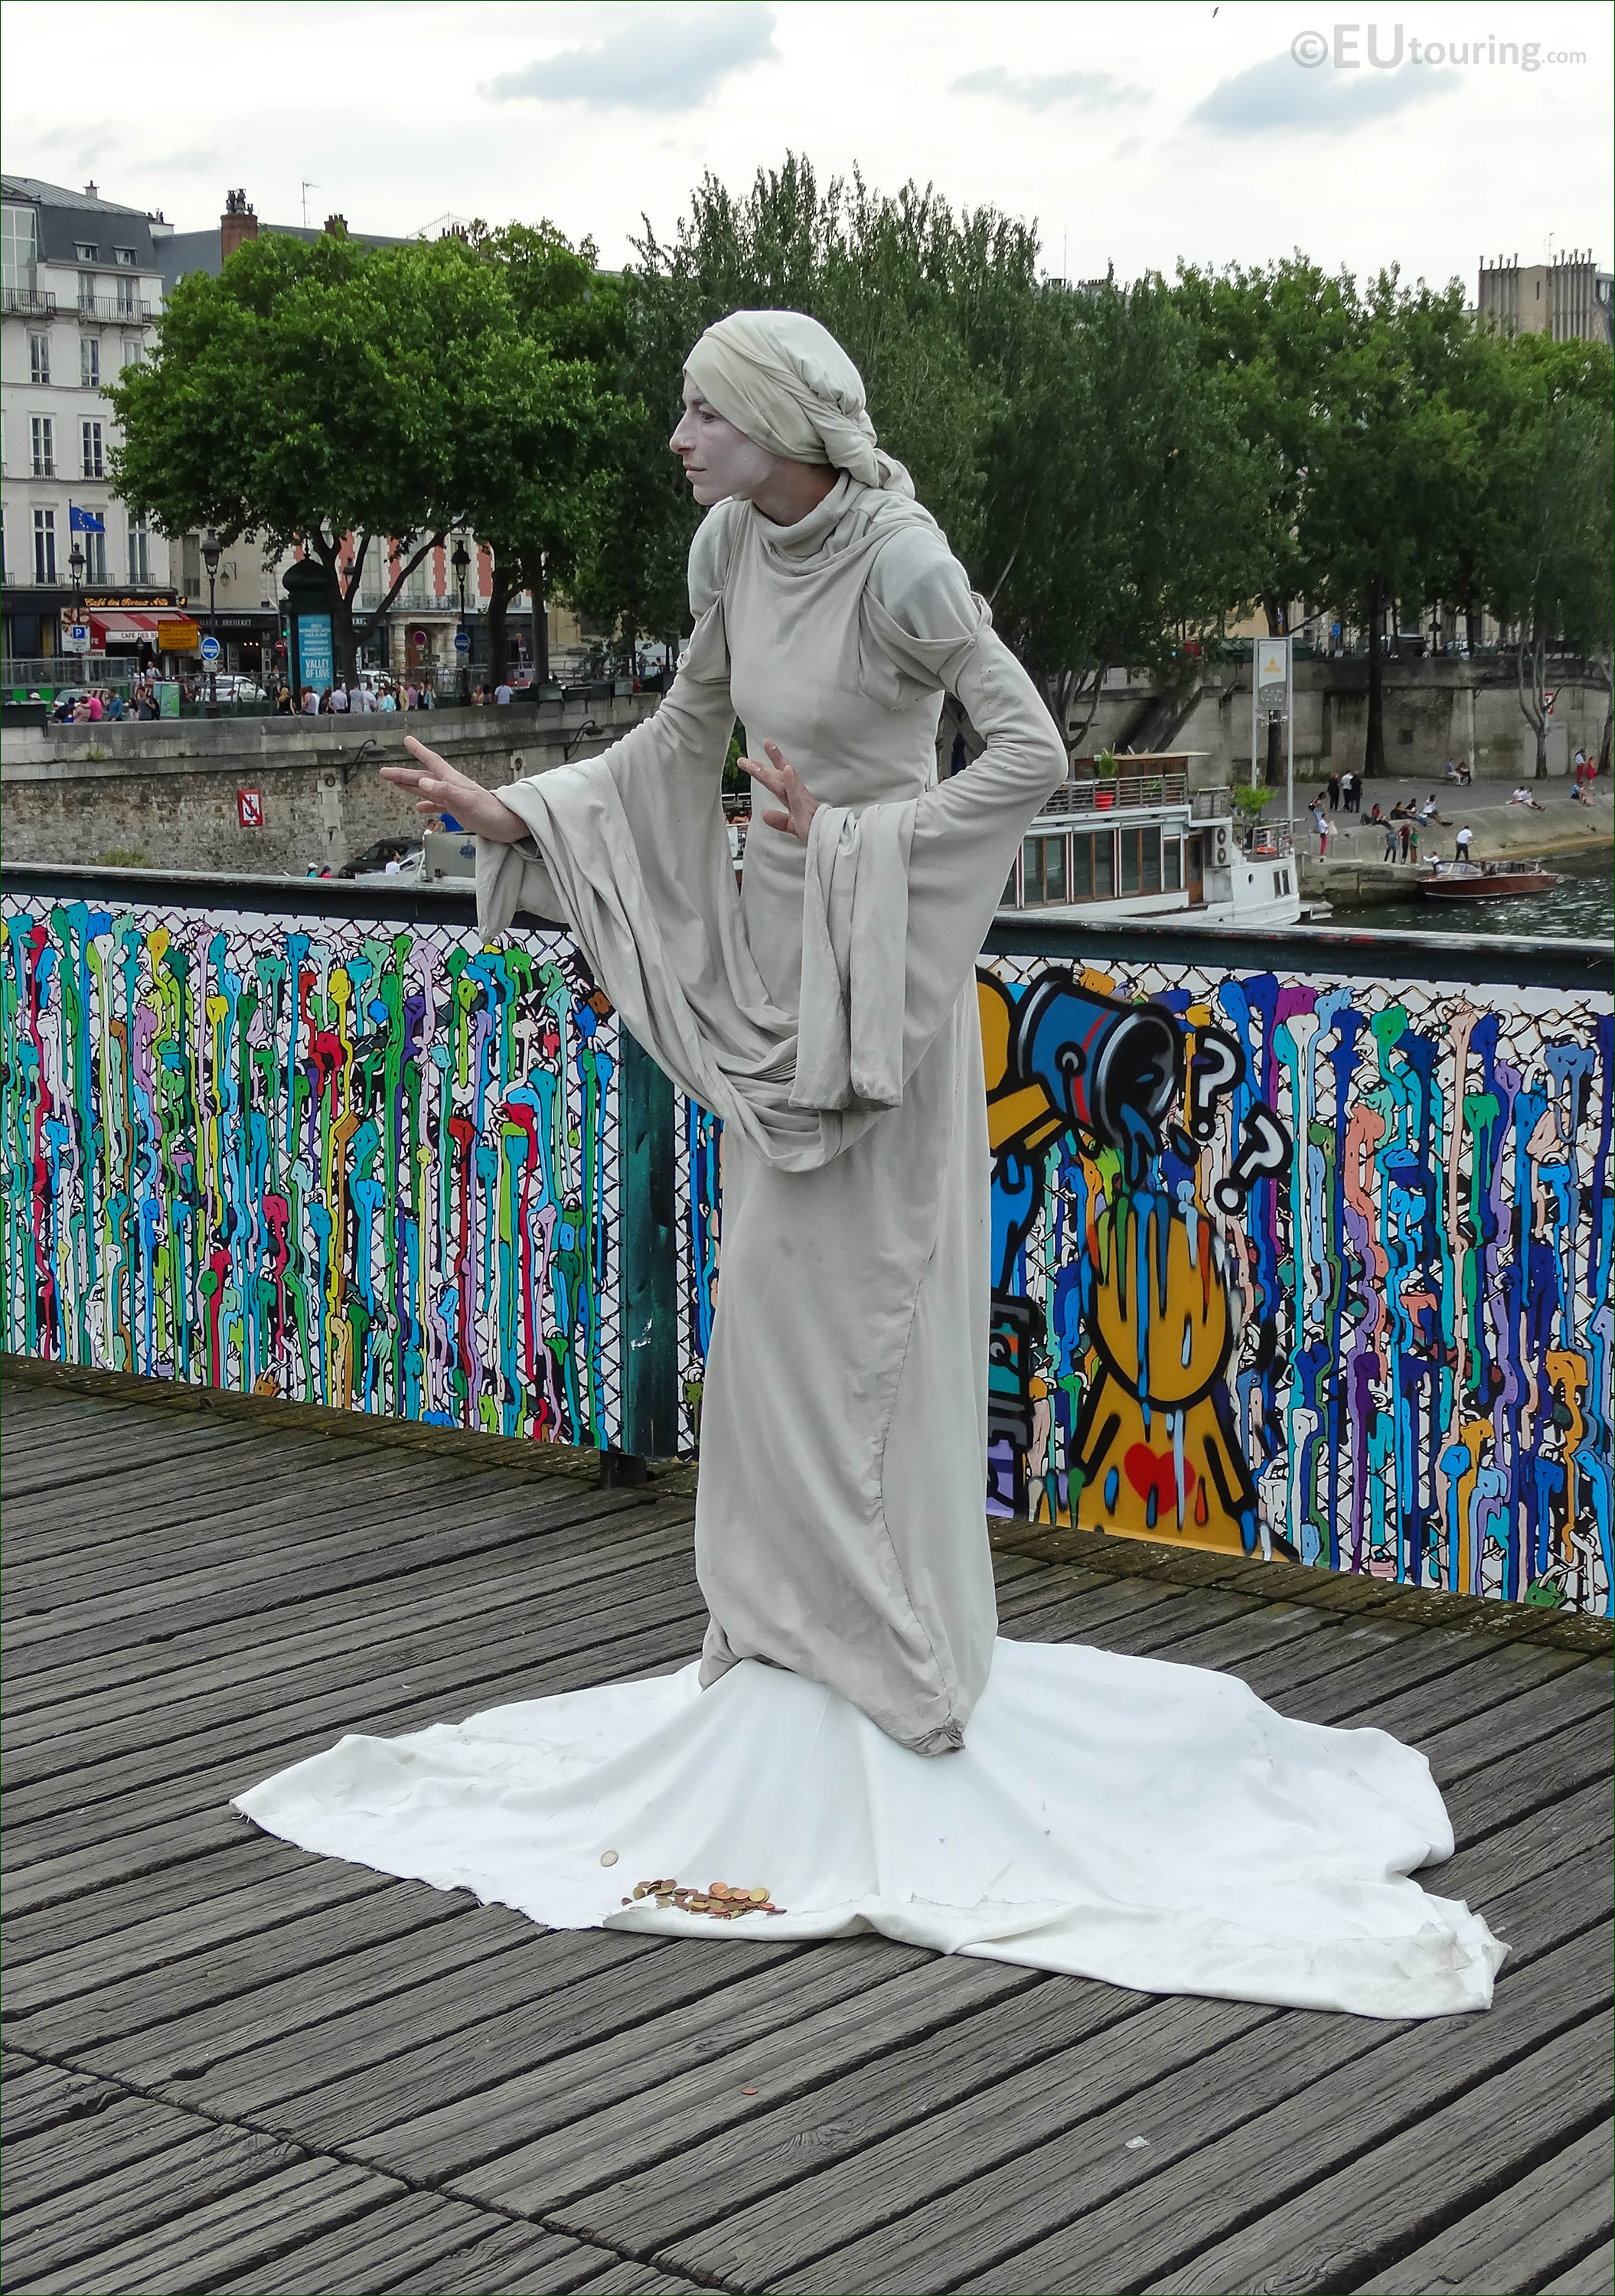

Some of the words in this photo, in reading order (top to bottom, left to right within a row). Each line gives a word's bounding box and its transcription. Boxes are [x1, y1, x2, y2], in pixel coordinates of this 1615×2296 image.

[75, 628, 83, 638] P
[305, 659, 329, 669] VALLEY
[305, 668, 315, 679] OF
[315, 668, 330, 678] LOVE
